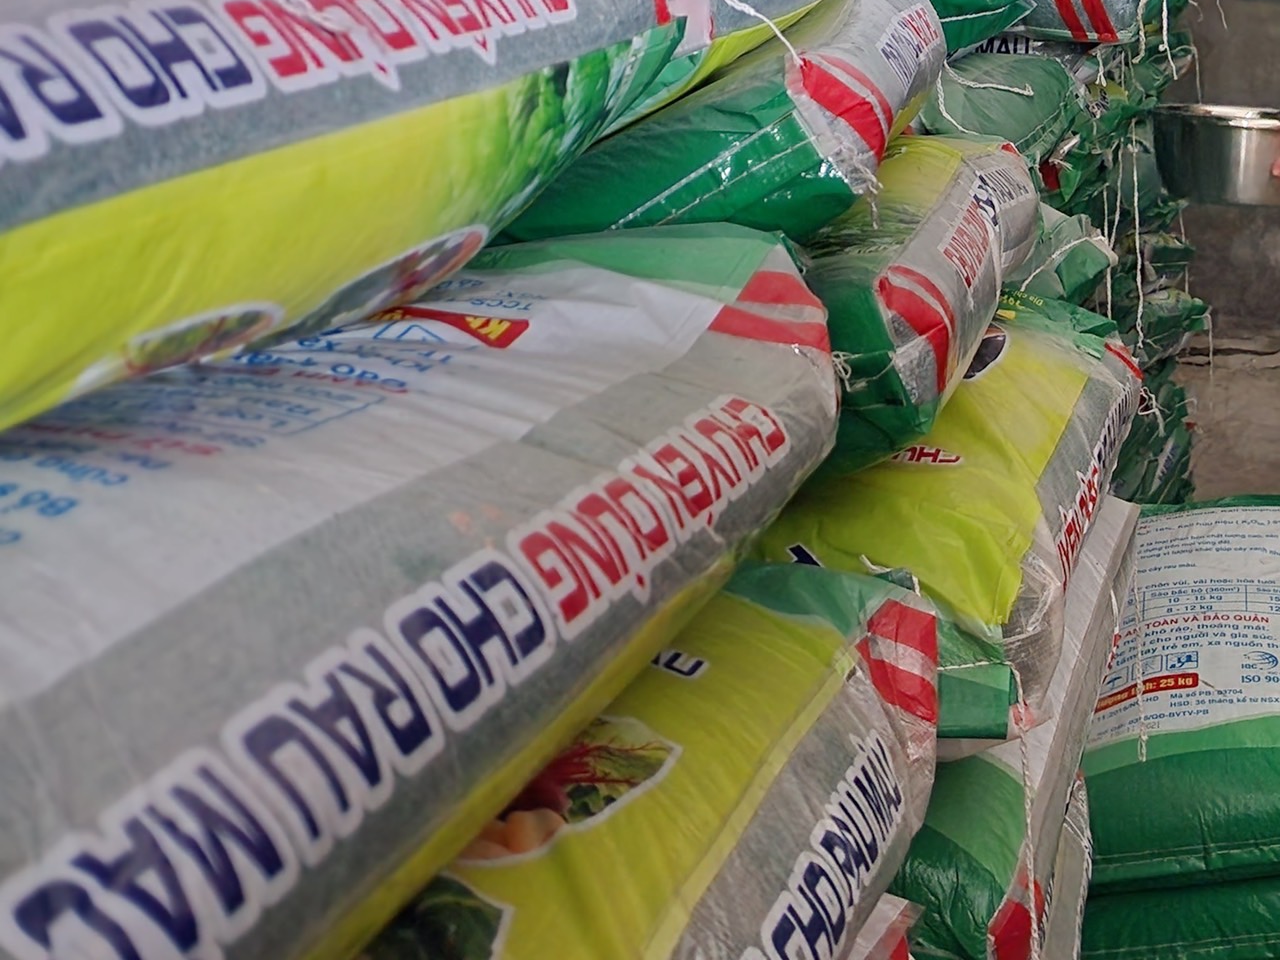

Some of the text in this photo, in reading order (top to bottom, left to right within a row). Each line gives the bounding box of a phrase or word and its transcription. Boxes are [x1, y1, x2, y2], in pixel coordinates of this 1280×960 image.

[67, 5, 255, 109] CHO
[632, 398, 786, 530] CHUYÊN
[519, 477, 669, 624] DÙNG
[399, 560, 547, 714] CHO
[1144, 617, 1178, 630] TOÀN
[1183, 613, 1199, 623] VÀ
[1203, 612, 1230, 621] BẢO
[1233, 613, 1269, 623] QUẢN
[1149, 636, 1171, 646] cho
[1197, 623, 1239, 631] thoáng
[1160, 676, 1193, 687] 25 kg
[1241, 675, 1261, 684] ISO
[241, 642, 432, 839] RAU
